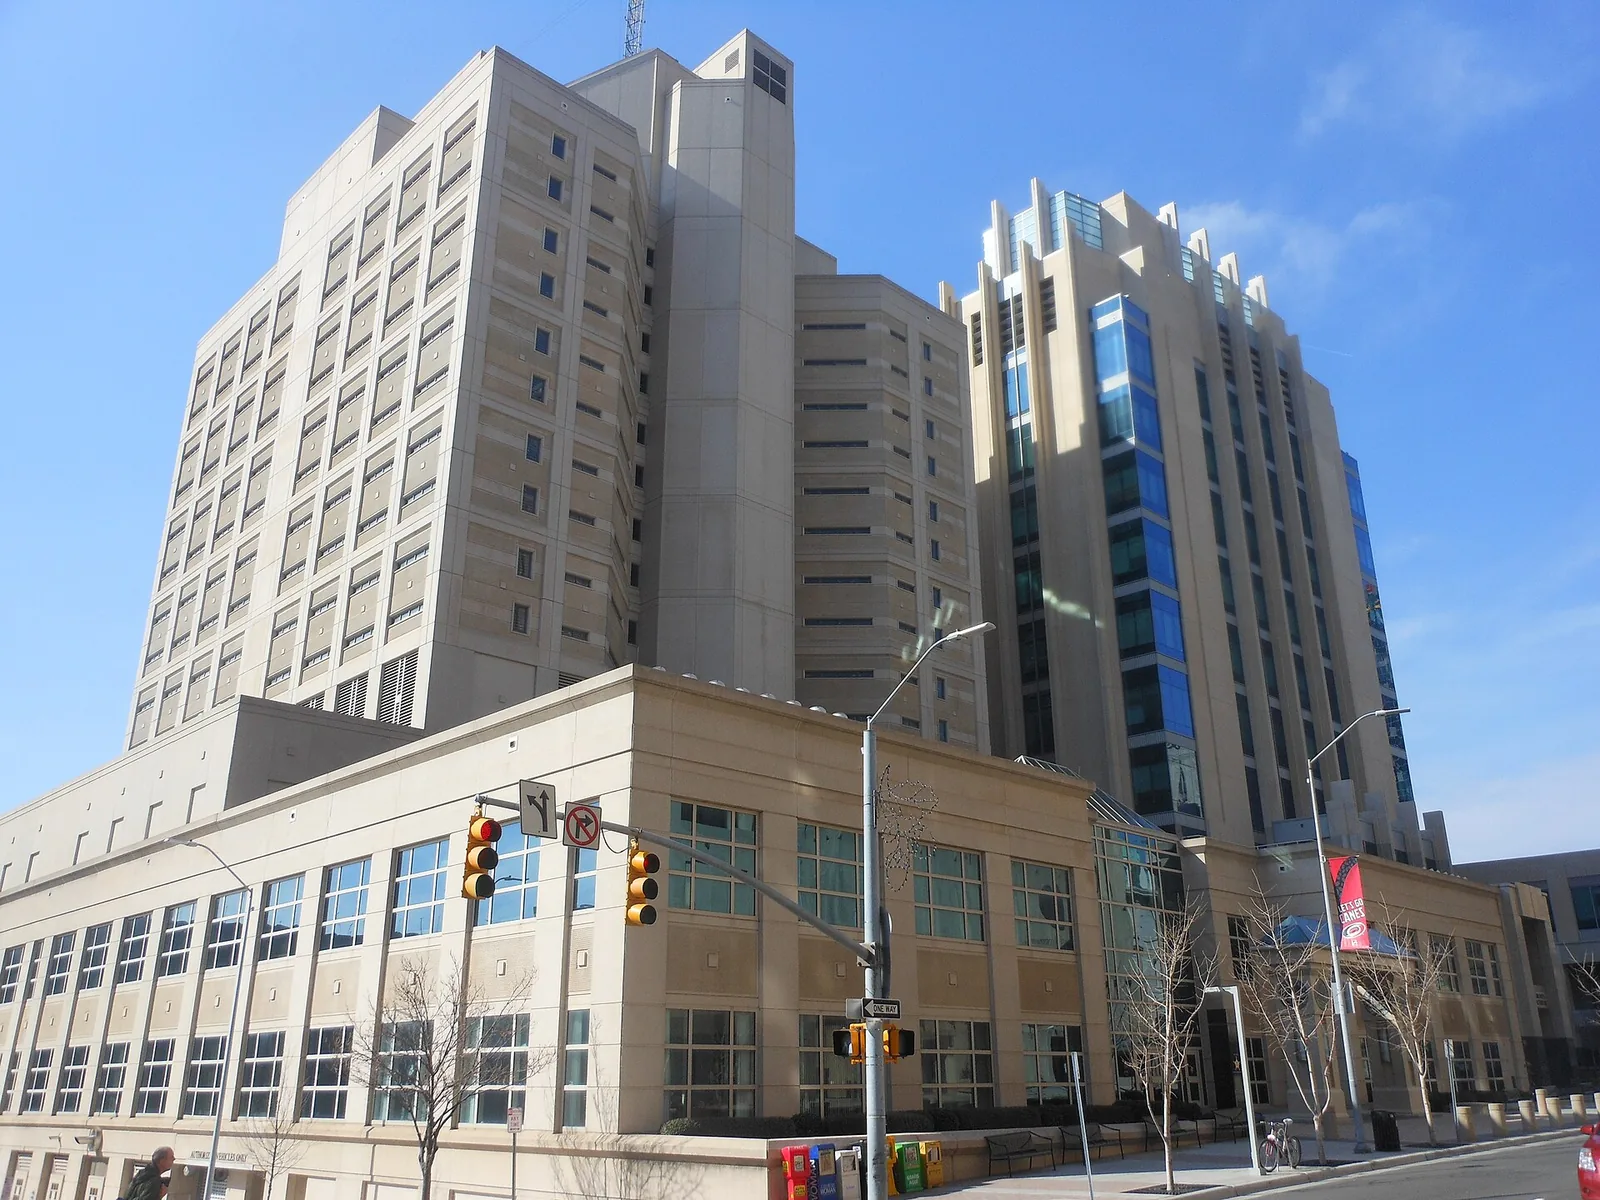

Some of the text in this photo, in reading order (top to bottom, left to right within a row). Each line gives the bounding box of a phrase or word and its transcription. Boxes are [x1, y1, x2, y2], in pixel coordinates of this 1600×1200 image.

[1338, 898, 1363, 914] LET'S GO
[1339, 907, 1365, 923] CANES
[873, 1004, 897, 1013] ONE WAY
